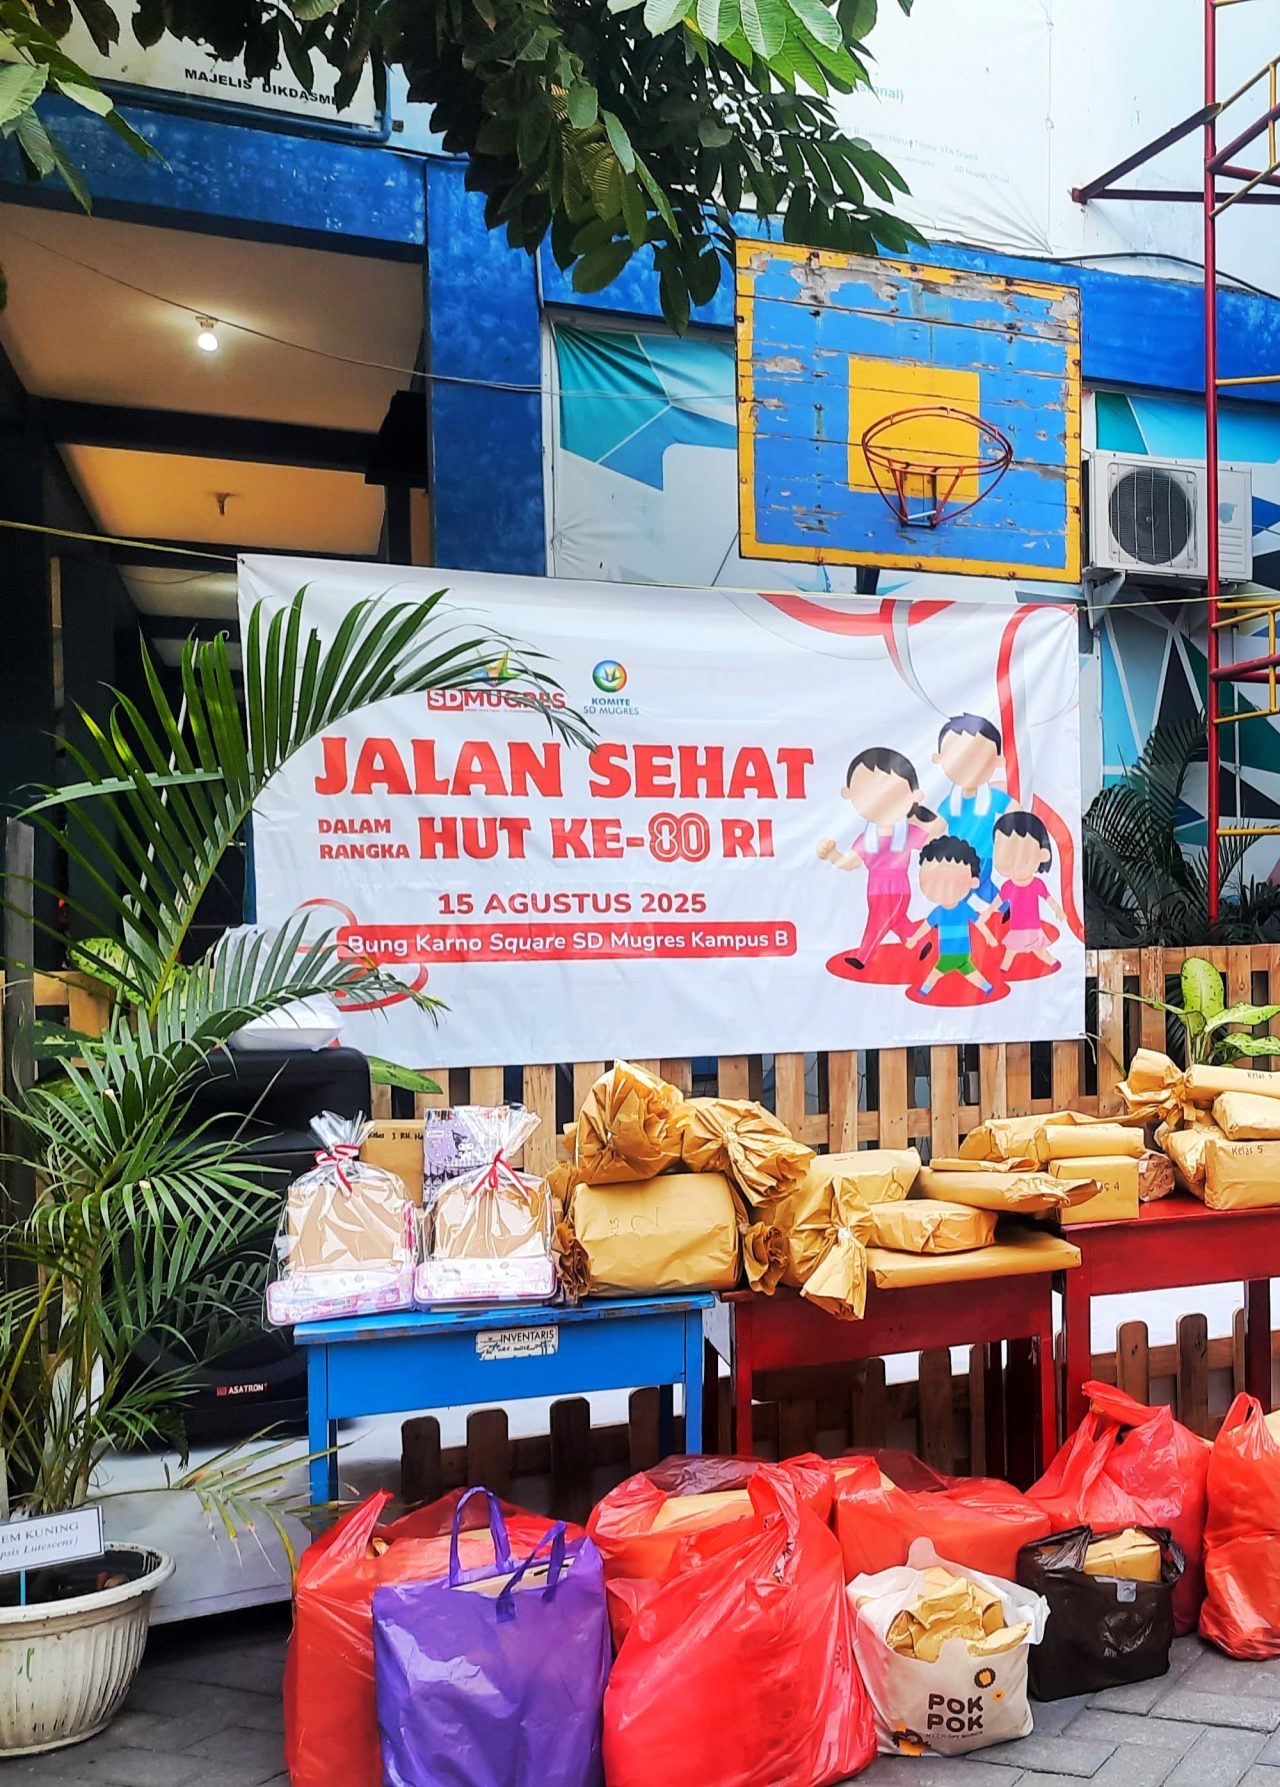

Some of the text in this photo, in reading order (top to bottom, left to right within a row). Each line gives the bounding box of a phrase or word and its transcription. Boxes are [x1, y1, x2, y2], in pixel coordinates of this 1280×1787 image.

[185, 69, 252, 90] MAJELIS
[584, 706, 640, 715] SD MUGRES
[591, 698, 631, 706] KOMITE
[314, 737, 815, 800] JALAN SEHAT
[318, 818, 391, 834] DALAM
[418, 812, 775, 863] HUT KE-80 RI
[319, 843, 410, 860] RANGKA
[438, 893, 707, 914] 15 AGUSTUS 2025
[348, 931, 788, 956] Bung Karno Square SD Mugres Kampus B
[1257, 1144, 1264, 1154] 5
[500, 1329, 555, 1344] INVENTARIS
[228, 1383, 264, 1394] ASATRON
[1, 1521, 79, 1545] EM KUNING
[0, 1548, 20, 1560] psis
[928, 1693, 984, 1714] POK
[927, 1713, 984, 1732] POK
